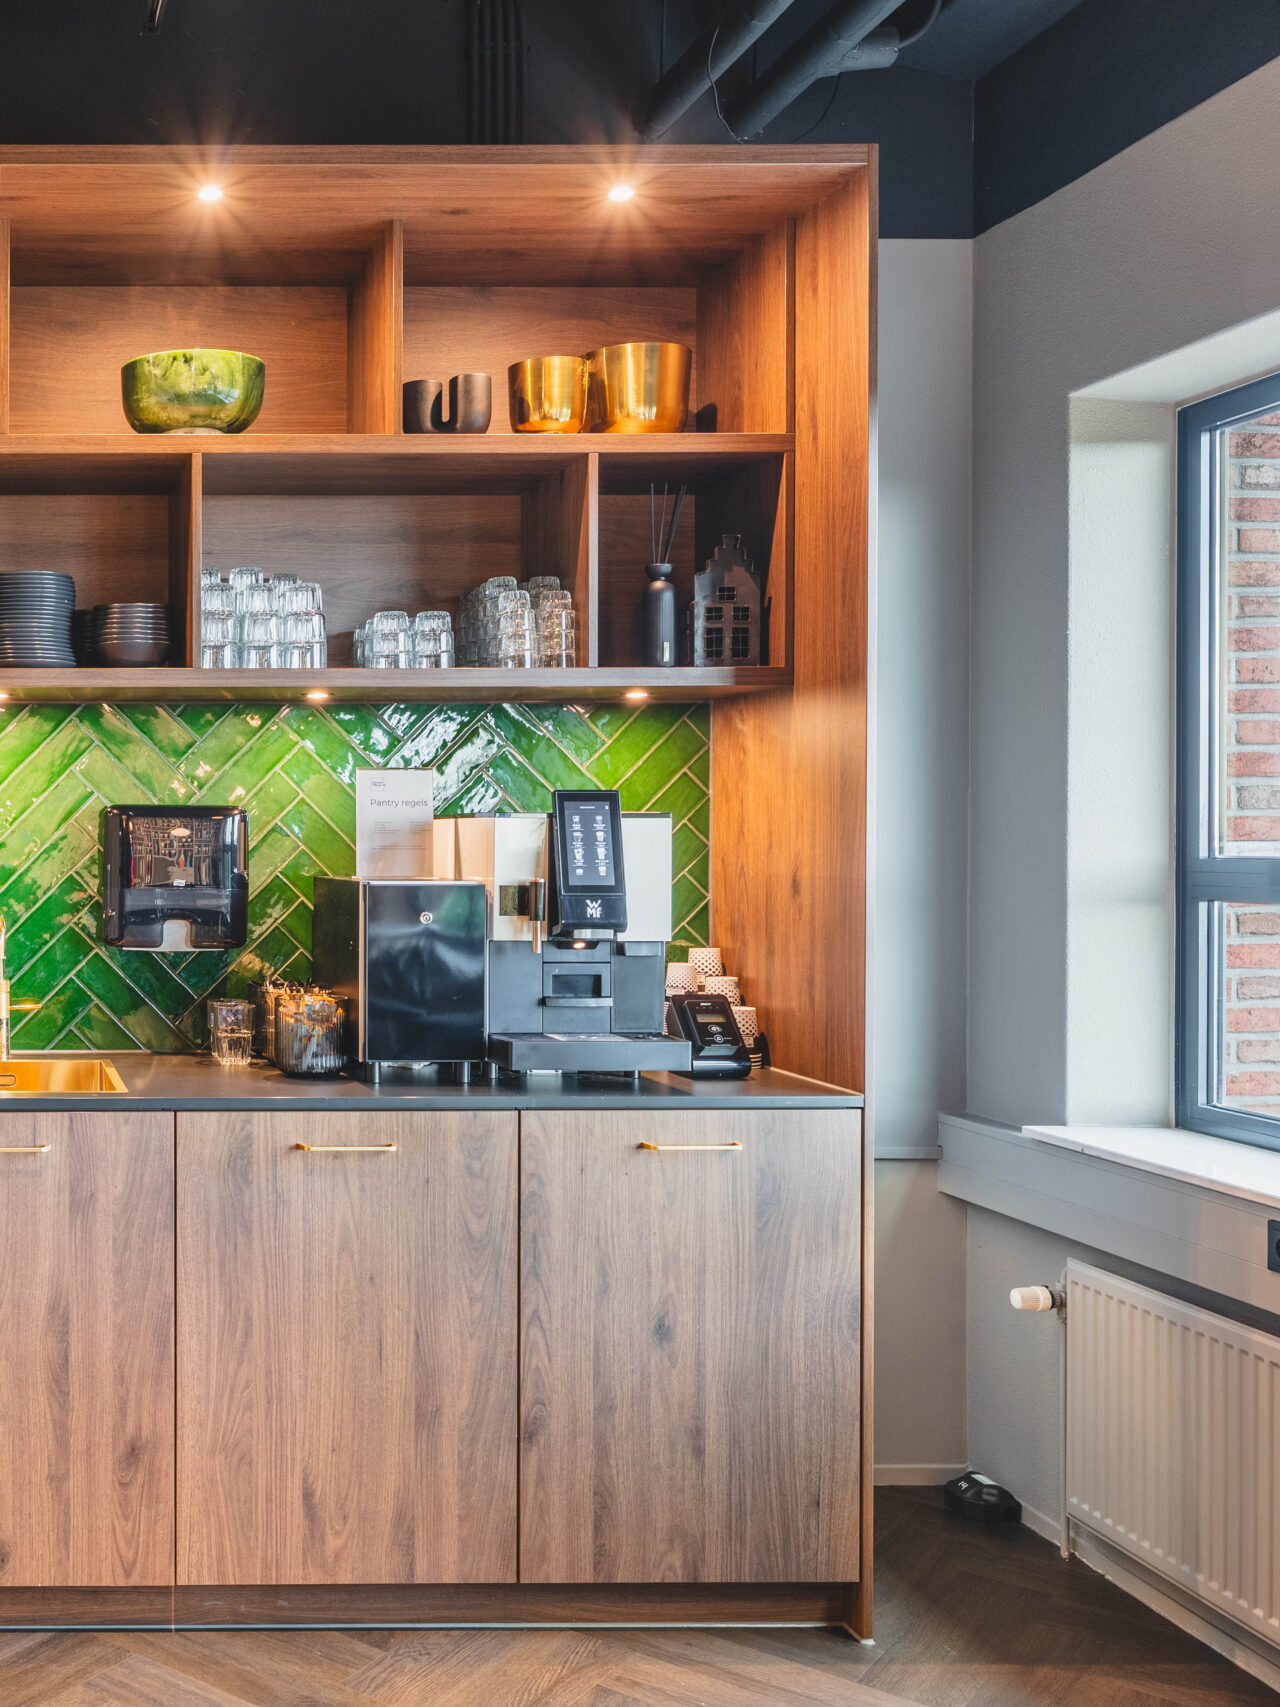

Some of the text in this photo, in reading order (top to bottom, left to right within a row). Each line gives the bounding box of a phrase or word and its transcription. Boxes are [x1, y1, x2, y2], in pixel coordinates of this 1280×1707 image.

[370, 798, 428, 808] Pantry regels
[586, 899, 602, 918] WMF
